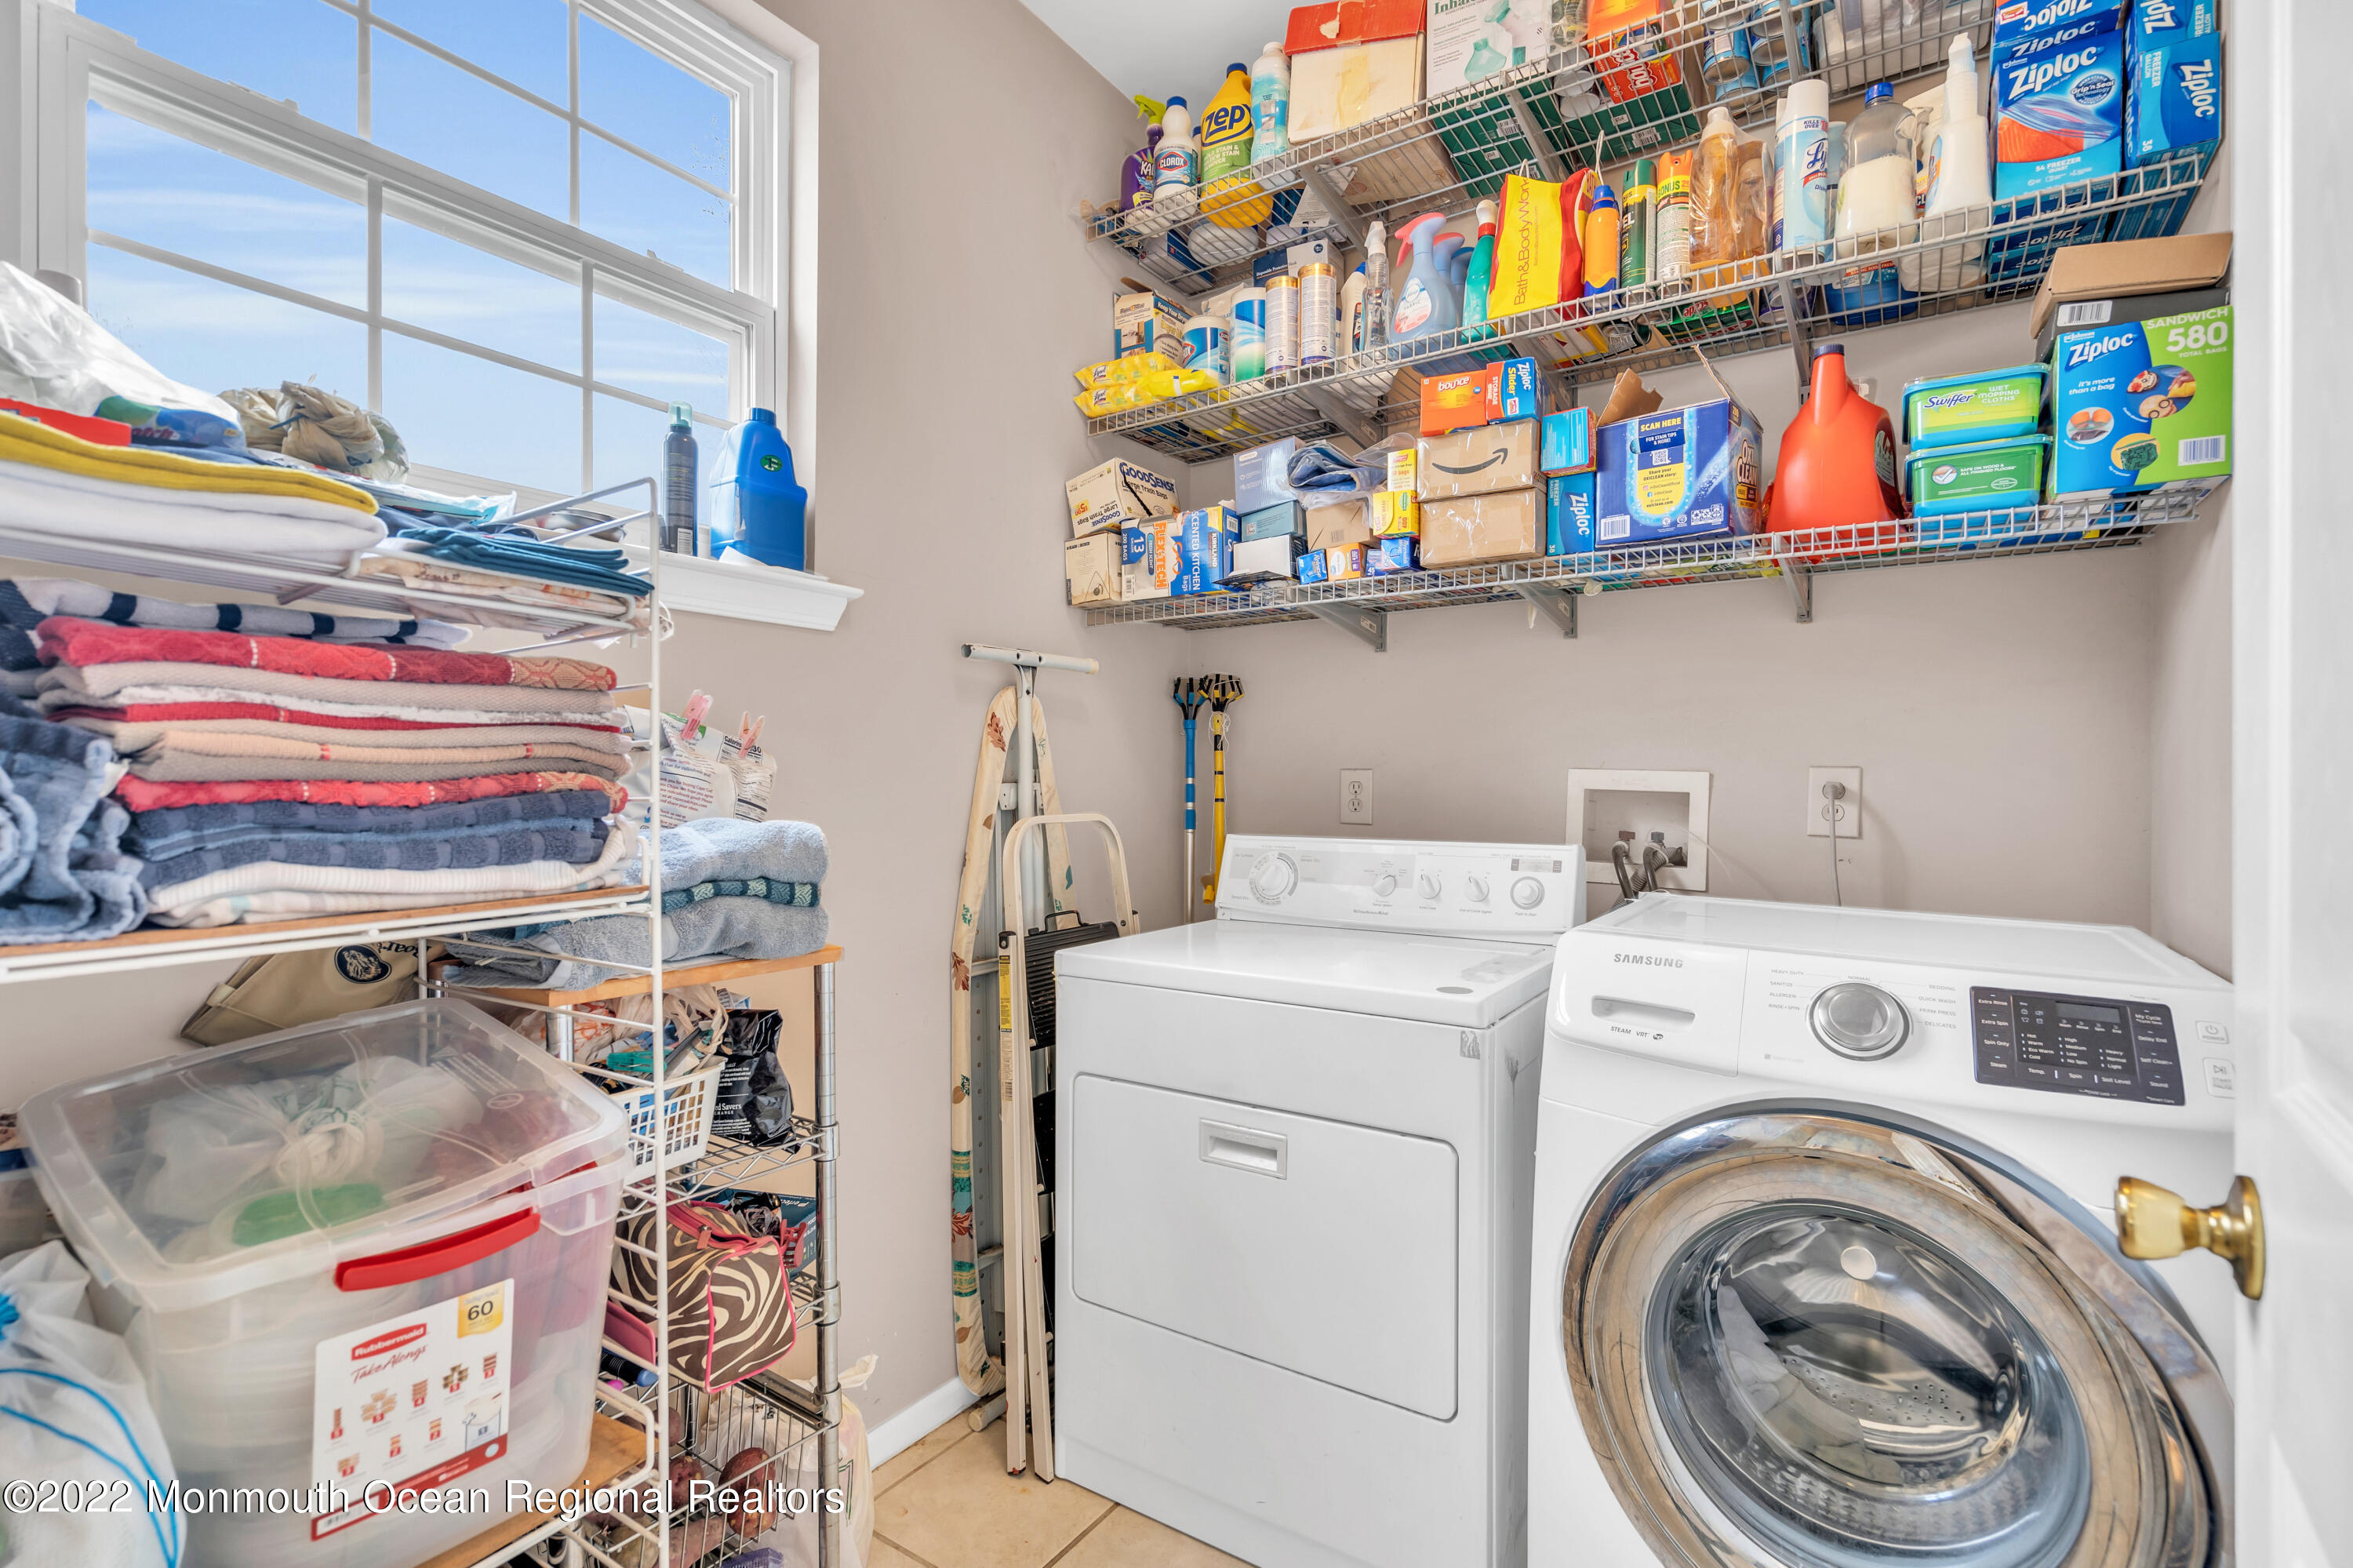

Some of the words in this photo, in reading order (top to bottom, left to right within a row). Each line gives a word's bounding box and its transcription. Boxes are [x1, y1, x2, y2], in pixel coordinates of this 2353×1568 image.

[2140, 0, 2177, 34] Zip
[2012, 21, 2096, 57] Ziploc
[2008, 46, 2097, 100] Ziploc
[2151, 51, 2162, 88] FREEZER
[2180, 59, 2217, 118] Ziploc
[2142, 140, 2153, 151] 38
[1159, 155, 1185, 168] CLOROX
[1806, 142, 1827, 172] Ly
[2046, 157, 2081, 169] FREEZER
[1657, 180, 1680, 197] BONUS
[1623, 214, 1635, 228] EL
[2146, 307, 2228, 329] SANDWICH
[2166, 321, 2228, 351] 580
[2069, 333, 2133, 366] Ziploc
[1438, 377, 1470, 391] bounce
[1507, 367, 1517, 395] Slider
[1517, 362, 1532, 391] Ziploc
[1978, 389, 2020, 398] MOPPING
[2097, 383, 2115, 391] bag
[1924, 394, 1973, 408] Swiffer
[1982, 395, 2015, 404] CLOTHS
[1640, 422, 1660, 431] SCAN
[1661, 417, 1682, 427] HERE
[1737, 457, 1758, 486] CLEAN
[1140, 485, 1155, 495] Trash
[1156, 490, 1169, 500] Bags
[1089, 509, 1104, 519] Trash
[1104, 504, 1118, 514] Large
[1569, 493, 1591, 536] Ziploc
[1077, 516, 1089, 526] Bags
[1133, 537, 1144, 553] 13
[1153, 521, 1168, 589] FLEX-TECH
[1192, 552, 1201, 591] KITCHEN
[1613, 953, 1684, 968] SAMSUNG
[1610, 1026, 1631, 1035] STEAM
[467, 1300, 494, 1321] 60
[354, 1326, 424, 1358] Rubbermaid
